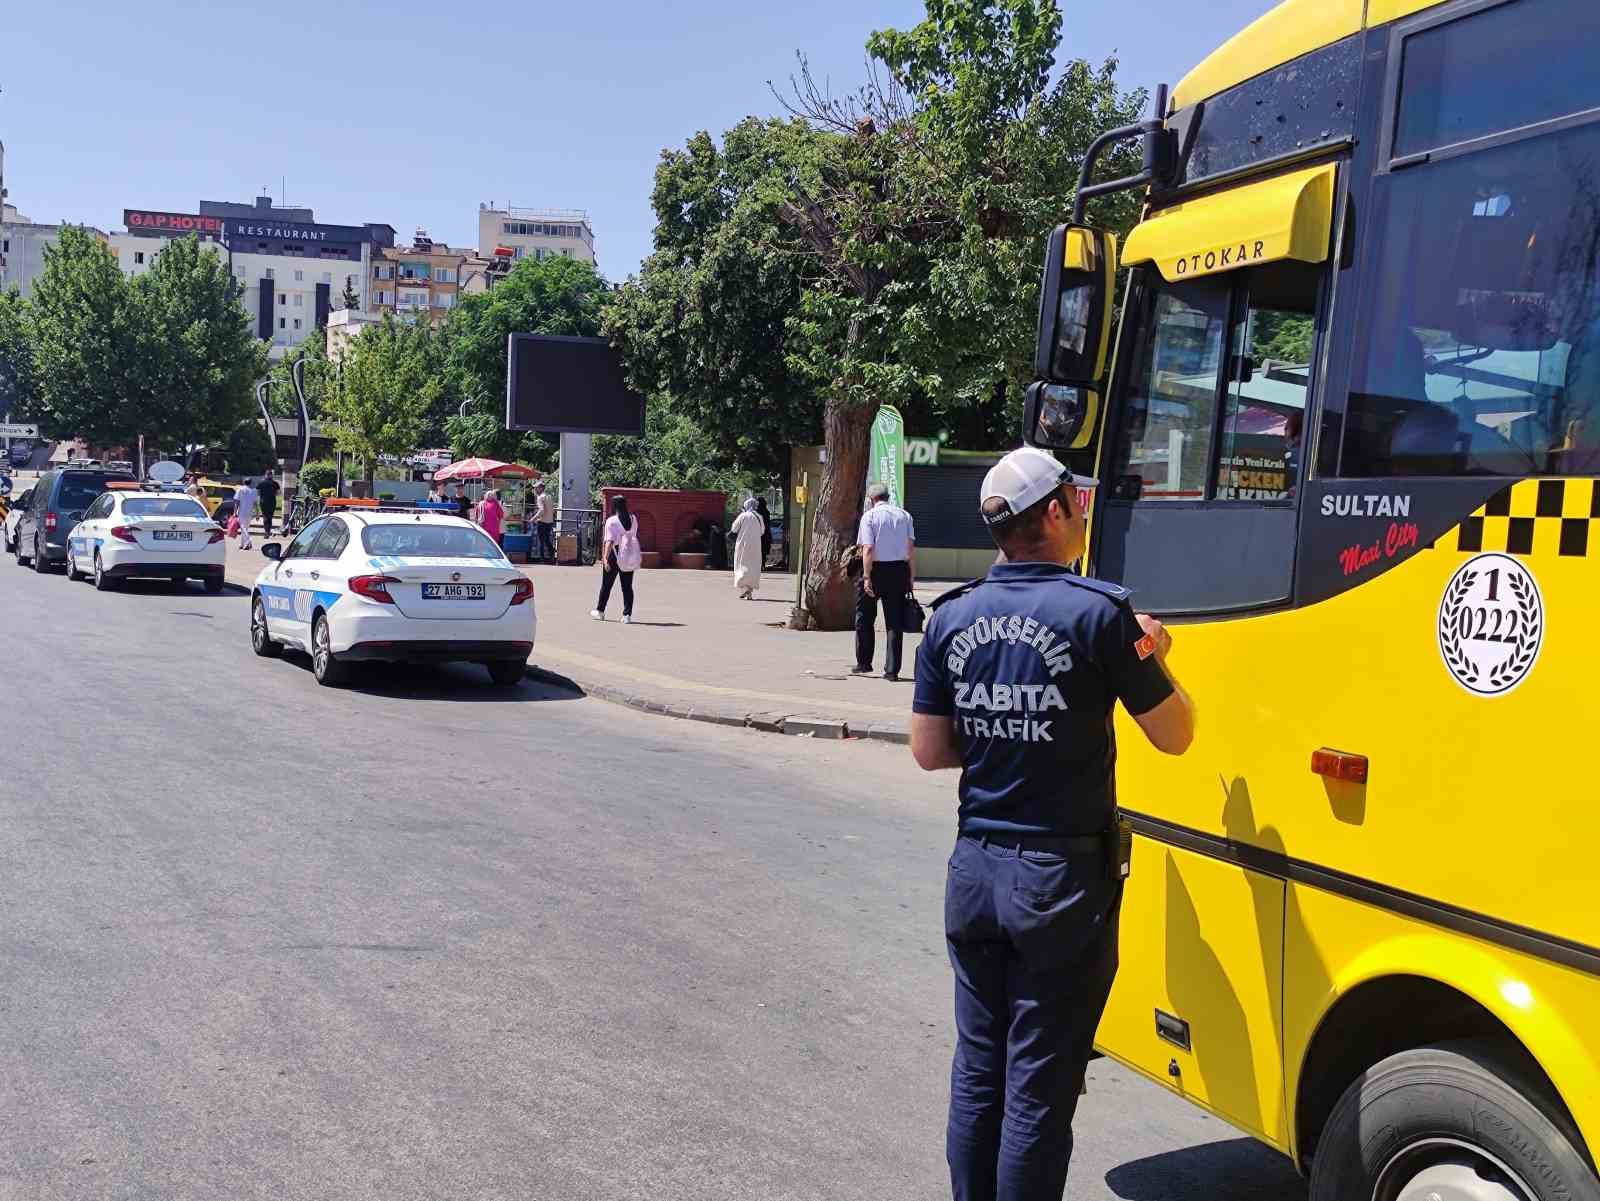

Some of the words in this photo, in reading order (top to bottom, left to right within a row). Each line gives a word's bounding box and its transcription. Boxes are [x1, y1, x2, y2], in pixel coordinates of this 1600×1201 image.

[129, 212, 167, 226] GAP
[238, 225, 326, 241] RESTAURANT
[1176, 240, 1264, 274] OTOKAR
[1320, 495, 1410, 517] SULTAN
[1339, 539, 1381, 576] Maxi
[1385, 522, 1418, 557] City
[428, 585, 440, 596] 27
[444, 585, 462, 596] AHG
[466, 585, 482, 596] 192
[1484, 568, 1501, 602] 1
[1458, 606, 1518, 644] 0222
[953, 682, 1068, 712] ZABITA
[961, 713, 1054, 742] TRAFİK
